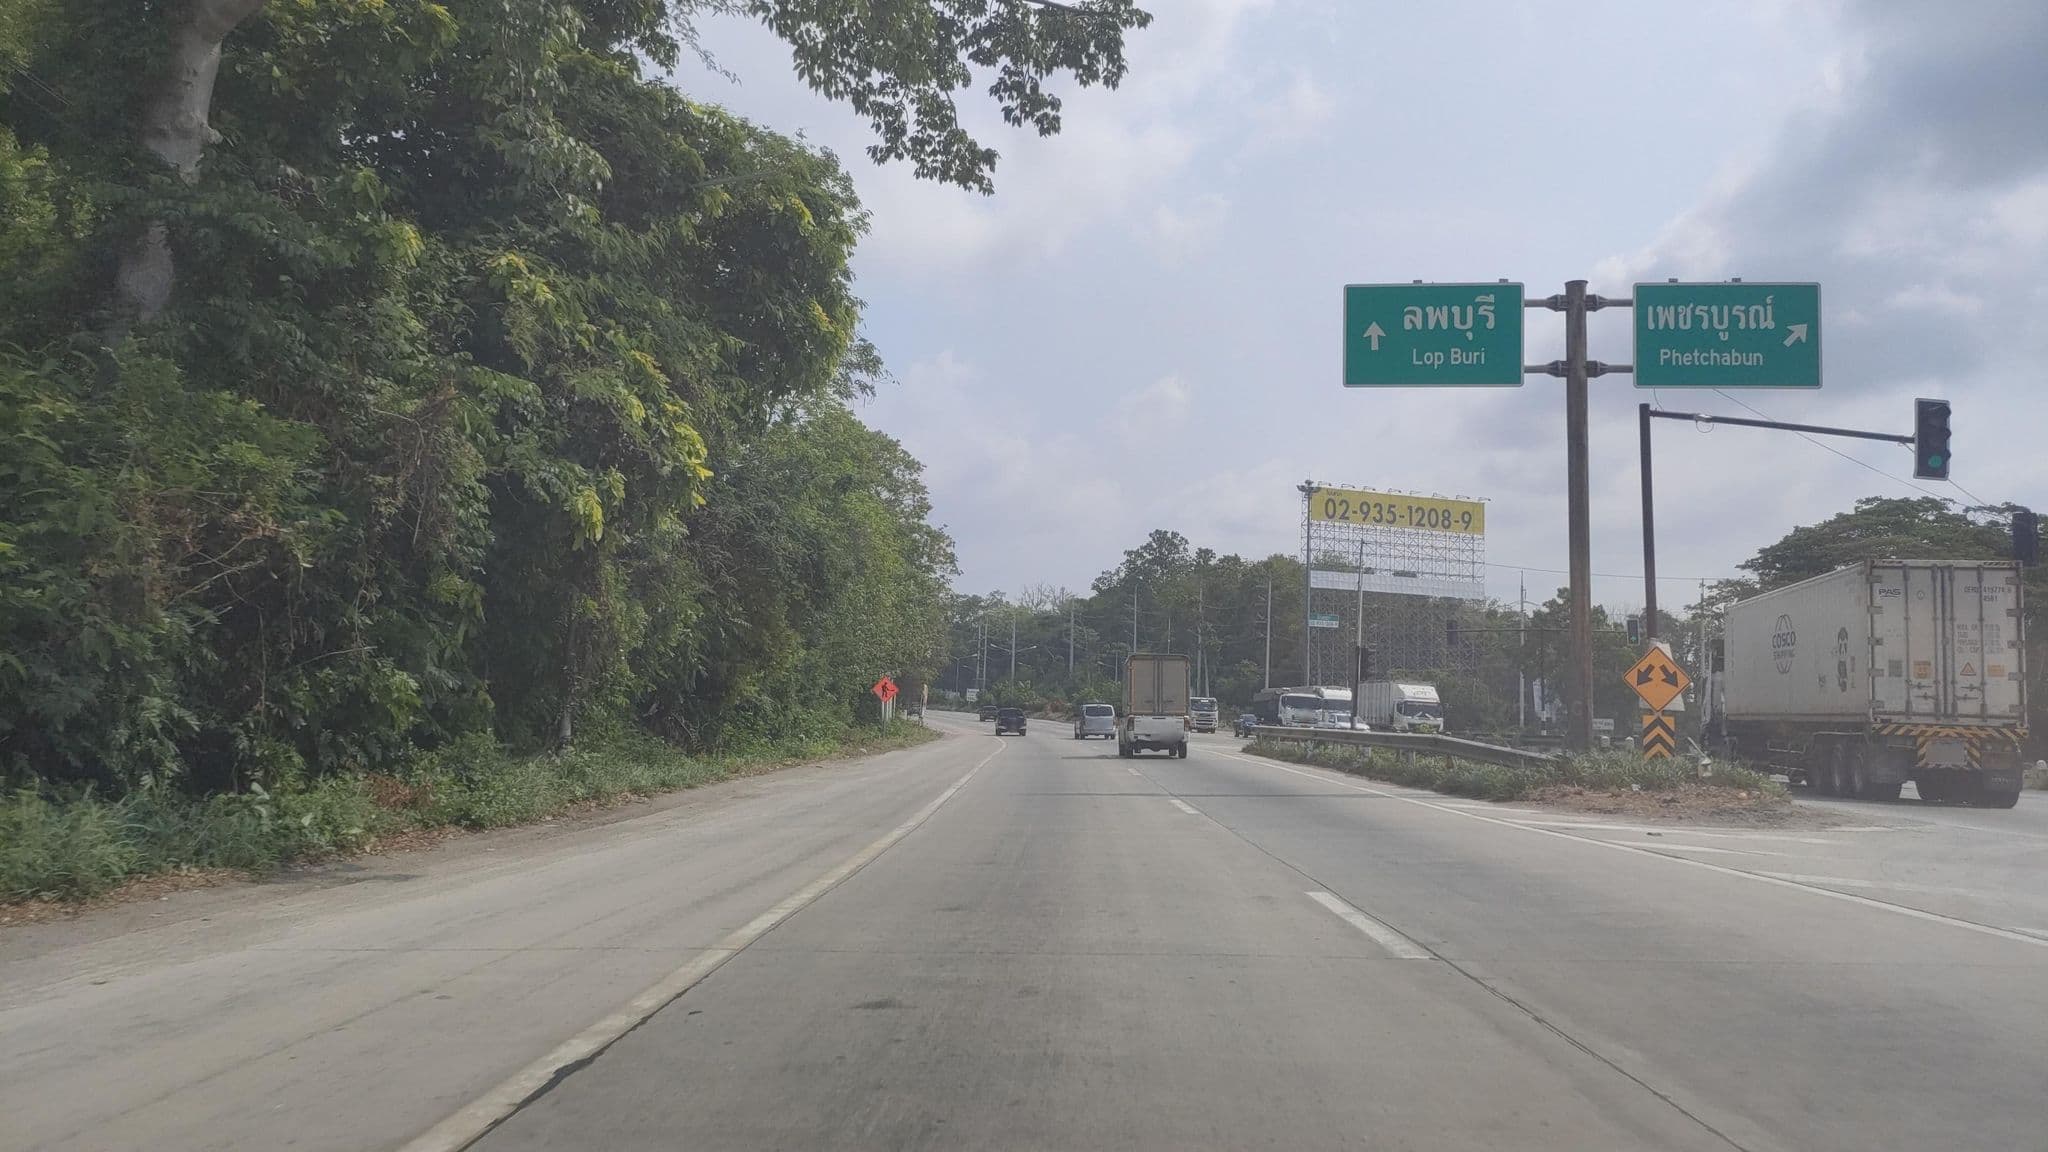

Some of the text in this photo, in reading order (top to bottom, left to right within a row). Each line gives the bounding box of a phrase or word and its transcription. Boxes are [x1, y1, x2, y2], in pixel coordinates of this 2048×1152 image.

[1403, 294, 1495, 341] ลพบุรี
[1647, 295, 1775, 341] เพชรบูรณ์
[1412, 347, 1486, 370] Lop Buri
[1660, 348, 1764, 366] Phetchabun
[1324, 498, 1473, 531] 02-935-1208-9
[1772, 631, 1797, 649] COSCO
